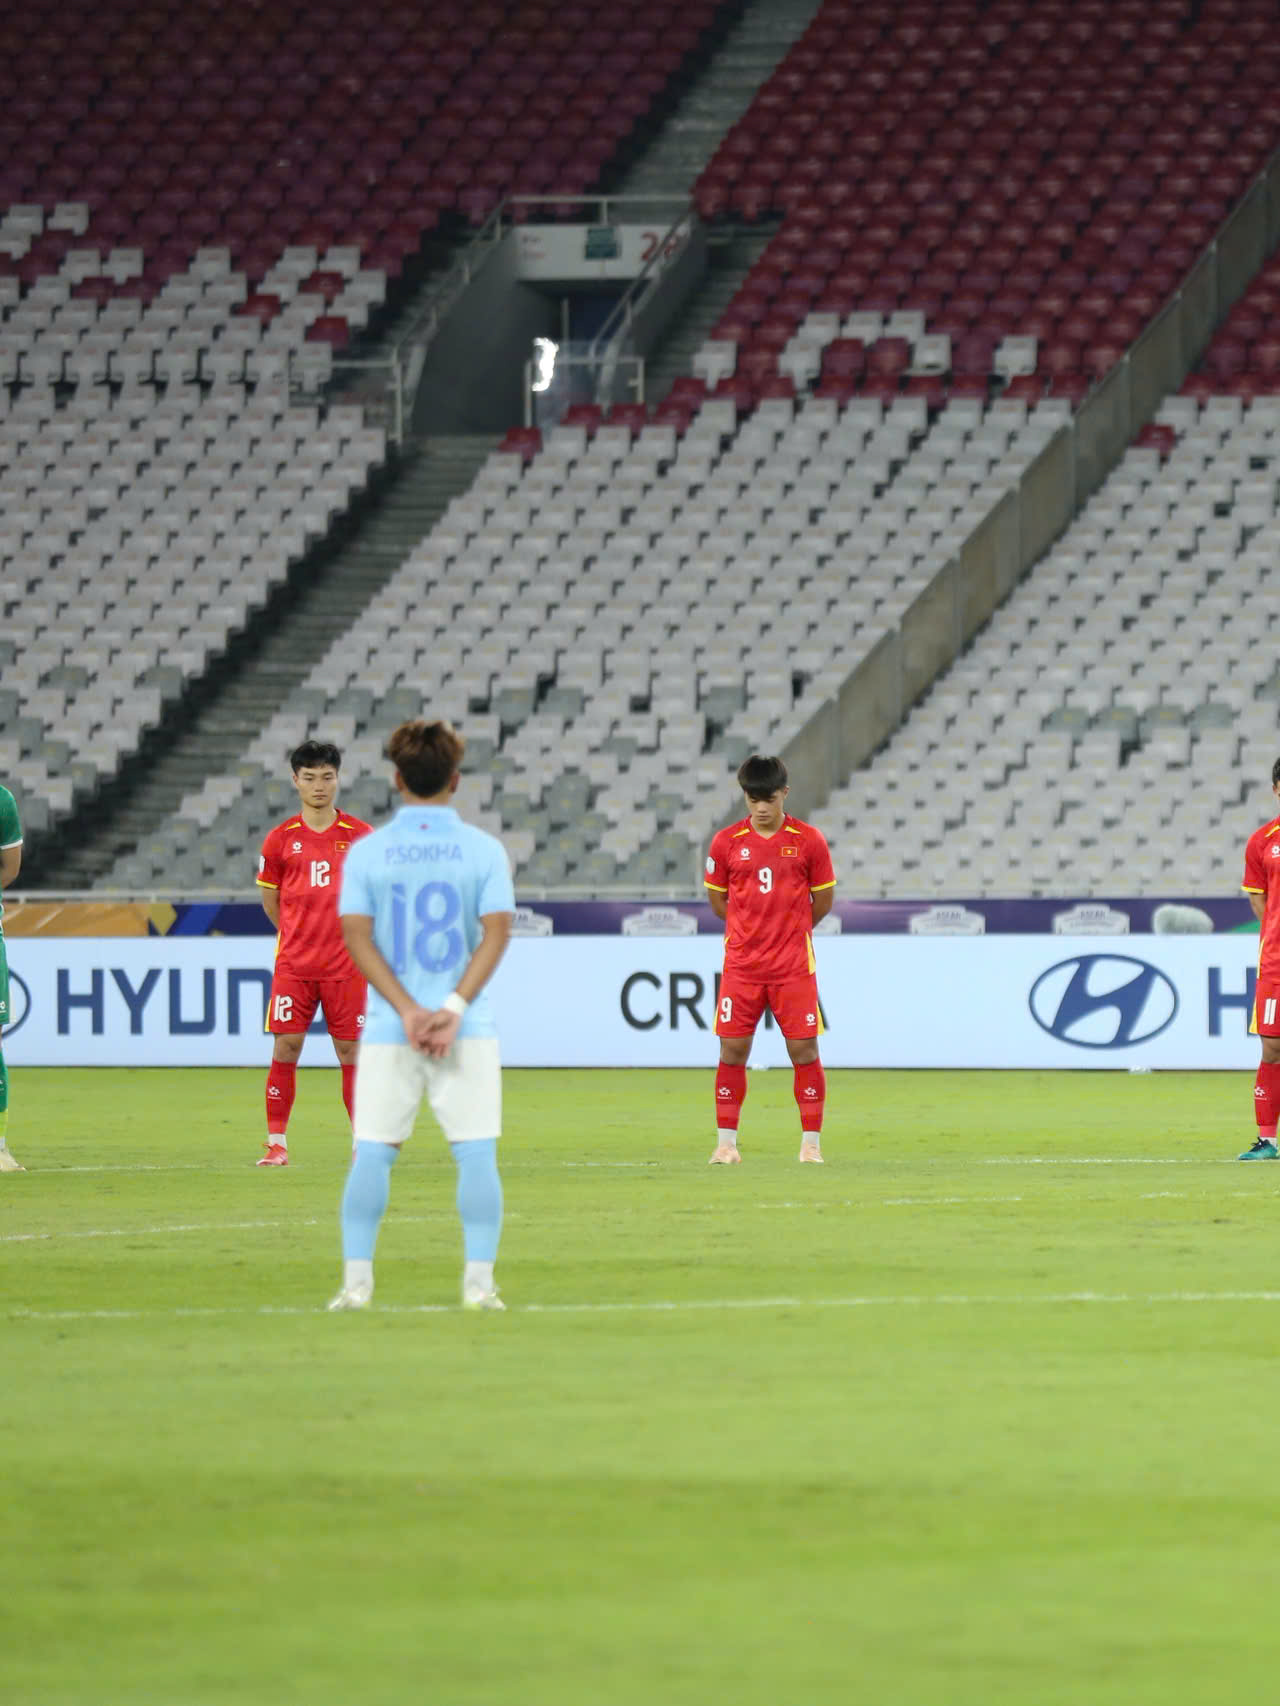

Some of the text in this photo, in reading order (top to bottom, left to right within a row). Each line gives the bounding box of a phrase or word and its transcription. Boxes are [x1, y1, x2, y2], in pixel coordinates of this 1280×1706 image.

[311, 860, 330, 888] 12
[758, 866, 773, 894] 9
[391, 881, 465, 975] 18
[57, 968, 330, 1035] HYUN
[273, 995, 293, 1022] 12
[720, 997, 732, 1023] 9
[1263, 998, 1277, 1025] 11
